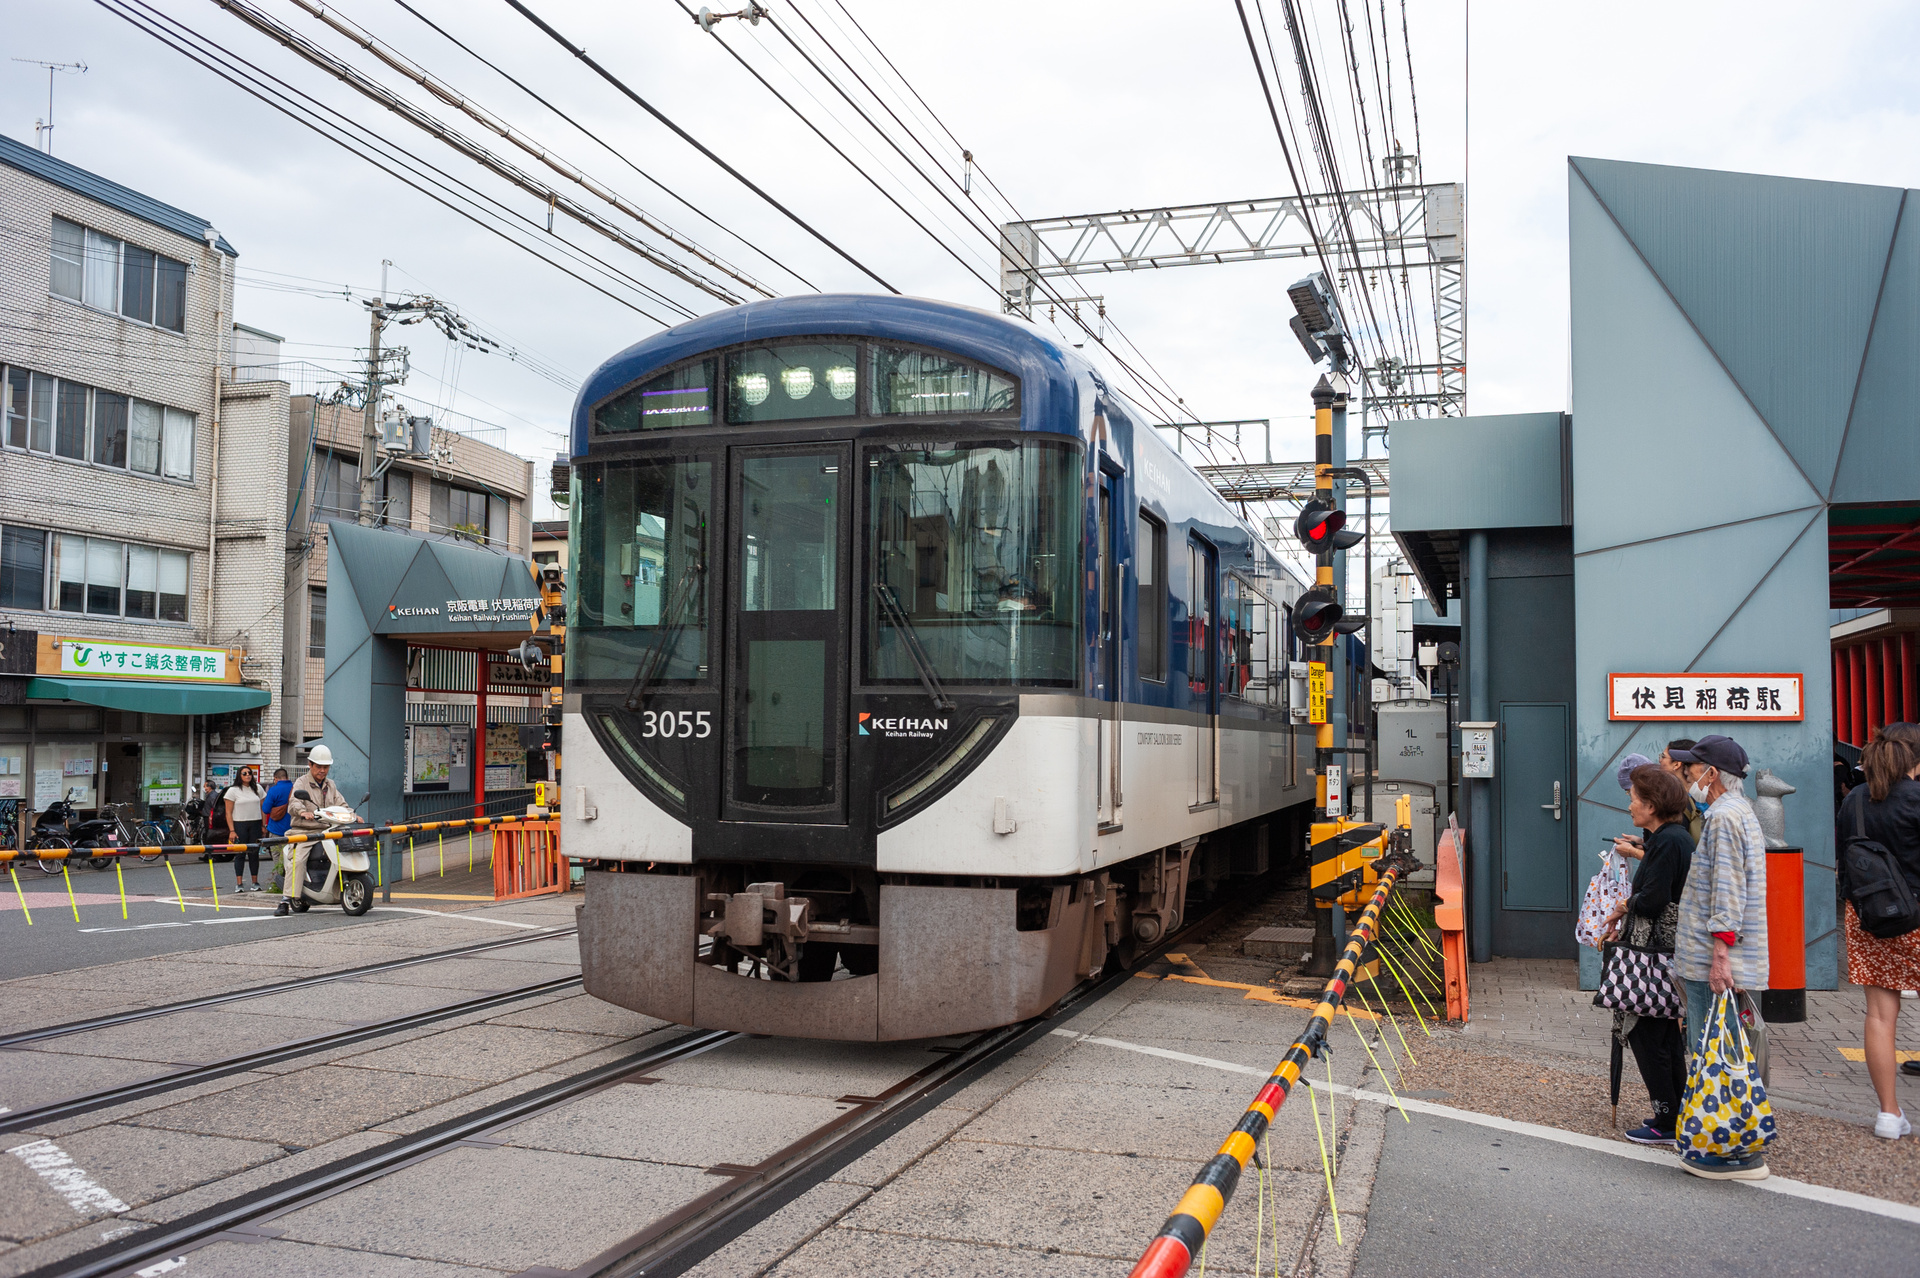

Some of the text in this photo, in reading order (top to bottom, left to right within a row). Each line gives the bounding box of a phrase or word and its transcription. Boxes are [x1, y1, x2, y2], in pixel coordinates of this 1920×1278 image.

[397, 606, 440, 616] KEIHAN
[446, 600, 489, 612] 京阪電車
[448, 614, 473, 622] Keihan
[473, 614, 501, 623] Railway
[98, 650, 217, 673] やすこ鍼灸整骨院
[1311, 666, 1325, 678] Danger
[1632, 686, 1782, 711] 伏見稲荷駅
[642, 710, 711, 738] 3055
[872, 717, 948, 730] KEIHAN
[908, 731, 934, 739] Railway
[1405, 729, 1418, 738] 1L
